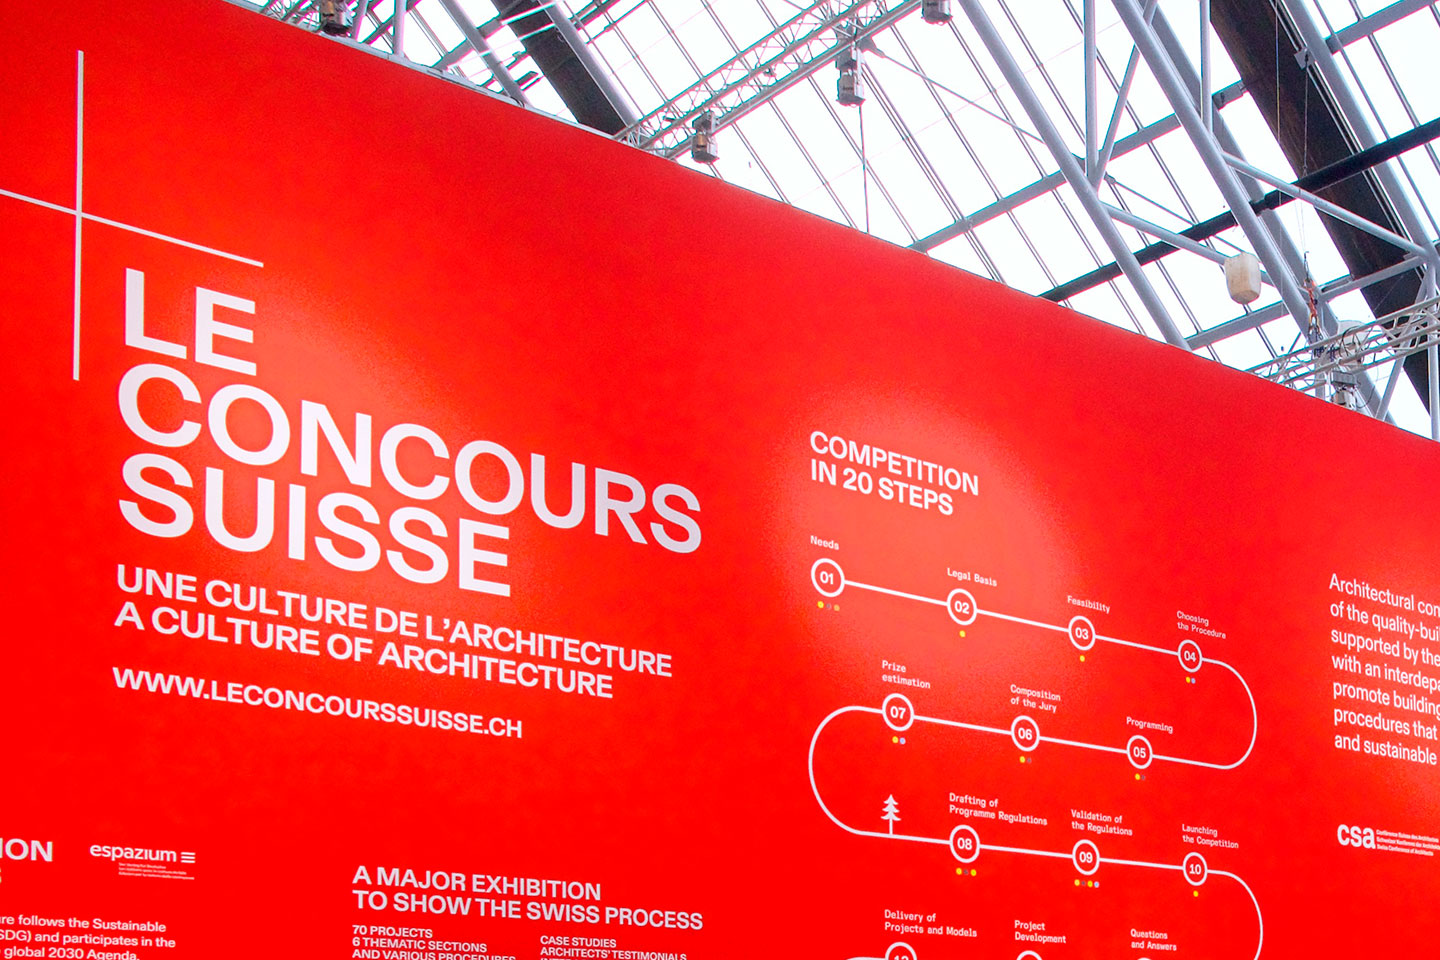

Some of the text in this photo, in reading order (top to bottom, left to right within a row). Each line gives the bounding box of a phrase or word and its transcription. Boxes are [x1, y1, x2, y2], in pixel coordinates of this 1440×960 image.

[126, 268, 257, 376] LE
[119, 364, 701, 553] CONCOURS
[811, 432, 978, 496] COMPETITION
[812, 459, 953, 515] IN 20 STEPS
[120, 454, 510, 597] SUISSE
[811, 536, 839, 550] Needs
[820, 571, 834, 584] 01
[948, 568, 997, 586] Legal Basis
[1330, 574, 1414, 611] Architectural
[118, 564, 197, 602] UNE
[206, 580, 368, 629] CULTURE
[376, 607, 418, 638] DE
[955, 601, 969, 614] 02
[1068, 595, 1110, 614] Feasibility
[1331, 603, 1344, 618] of
[1347, 605, 1368, 624] the
[1076, 627, 1088, 640] 03
[115, 602, 613, 698] A CULTURE OF ARCHITECTURE
[1332, 630, 1400, 657] supported
[1404, 643, 1418, 665] by
[1182, 650, 1196, 664] 04
[882, 660, 906, 672] Prize
[1332, 655, 1361, 674] with
[1365, 664, 1381, 678] an
[882, 674, 930, 689] estimation
[1334, 682, 1390, 706] promote
[113, 667, 522, 738] WWW.LECONCOURSSUISSE.CH
[890, 706, 906, 719] 07
[1127, 716, 1173, 734] Programming
[1334, 709, 1410, 735] procedures
[1412, 721, 1438, 740] that
[1018, 728, 1032, 740] 06
[1134, 746, 1146, 758] 05
[1335, 735, 1360, 751] and
[1364, 741, 1437, 765] sustainable
[950, 792, 998, 808] Drafting of
[950, 804, 1048, 826] Programme Regulations
[958, 838, 972, 850] 08
[1338, 824, 1376, 849] csa
[90, 845, 176, 862] espazium
[1080, 852, 1093, 863] 09
[1190, 864, 1202, 875] 10
[352, 866, 600, 900] A MAJOR EXHIBITION
[352, 890, 703, 930] TO SHOW THE SWISS PROCESS
[885, 910, 936, 924] Delivery of
[352, 925, 433, 938] 70 PROJECTS
[885, 922, 977, 937] Projects and Models
[1015, 920, 1045, 934] Project
[352, 937, 487, 953] 6 THEMATIC SECTIONS
[540, 936, 616, 948] CASE STUDIES
[1015, 932, 1066, 944] Development
[4, 946, 45, 959] global
[48, 947, 84, 959] 2030
[352, 949, 380, 959] AND
